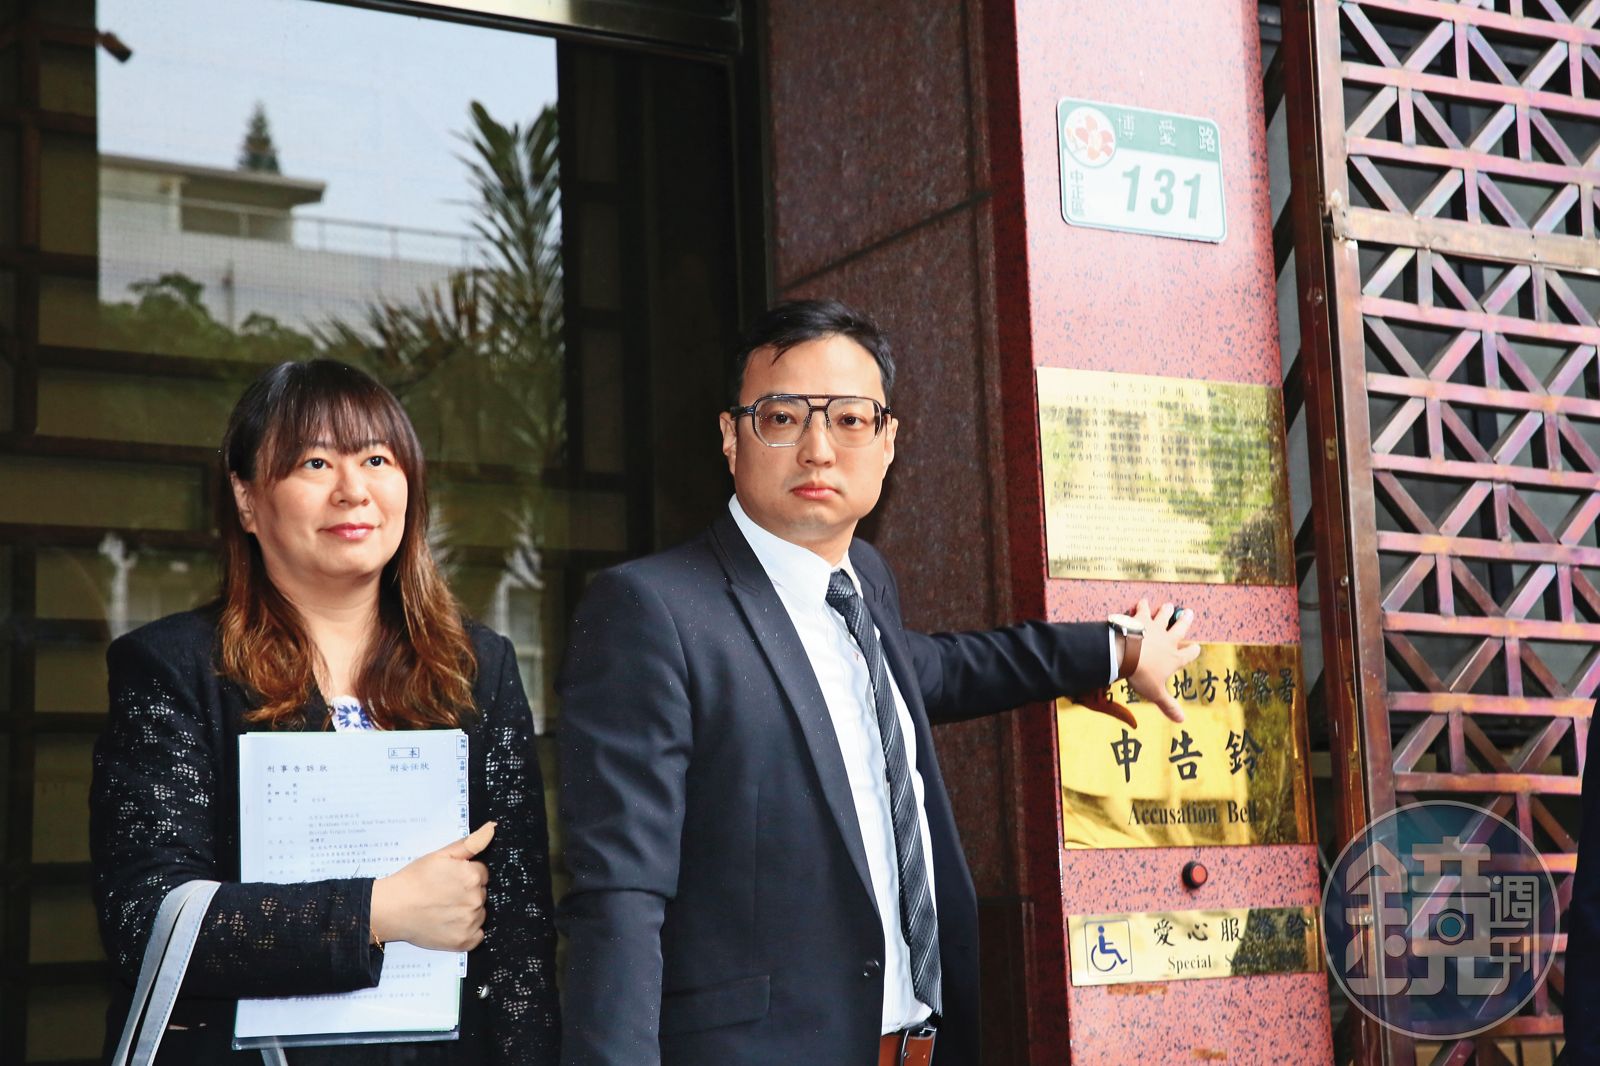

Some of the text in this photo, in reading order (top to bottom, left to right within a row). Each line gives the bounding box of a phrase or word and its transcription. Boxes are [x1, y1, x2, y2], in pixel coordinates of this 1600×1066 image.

[1118, 114, 1215, 152] 博愛路
[1122, 165, 1202, 220] 131
[1110, 727, 1264, 783] 申告鈴
[1128, 799, 1218, 826] Accusation
[1168, 952, 1213, 976] Special
